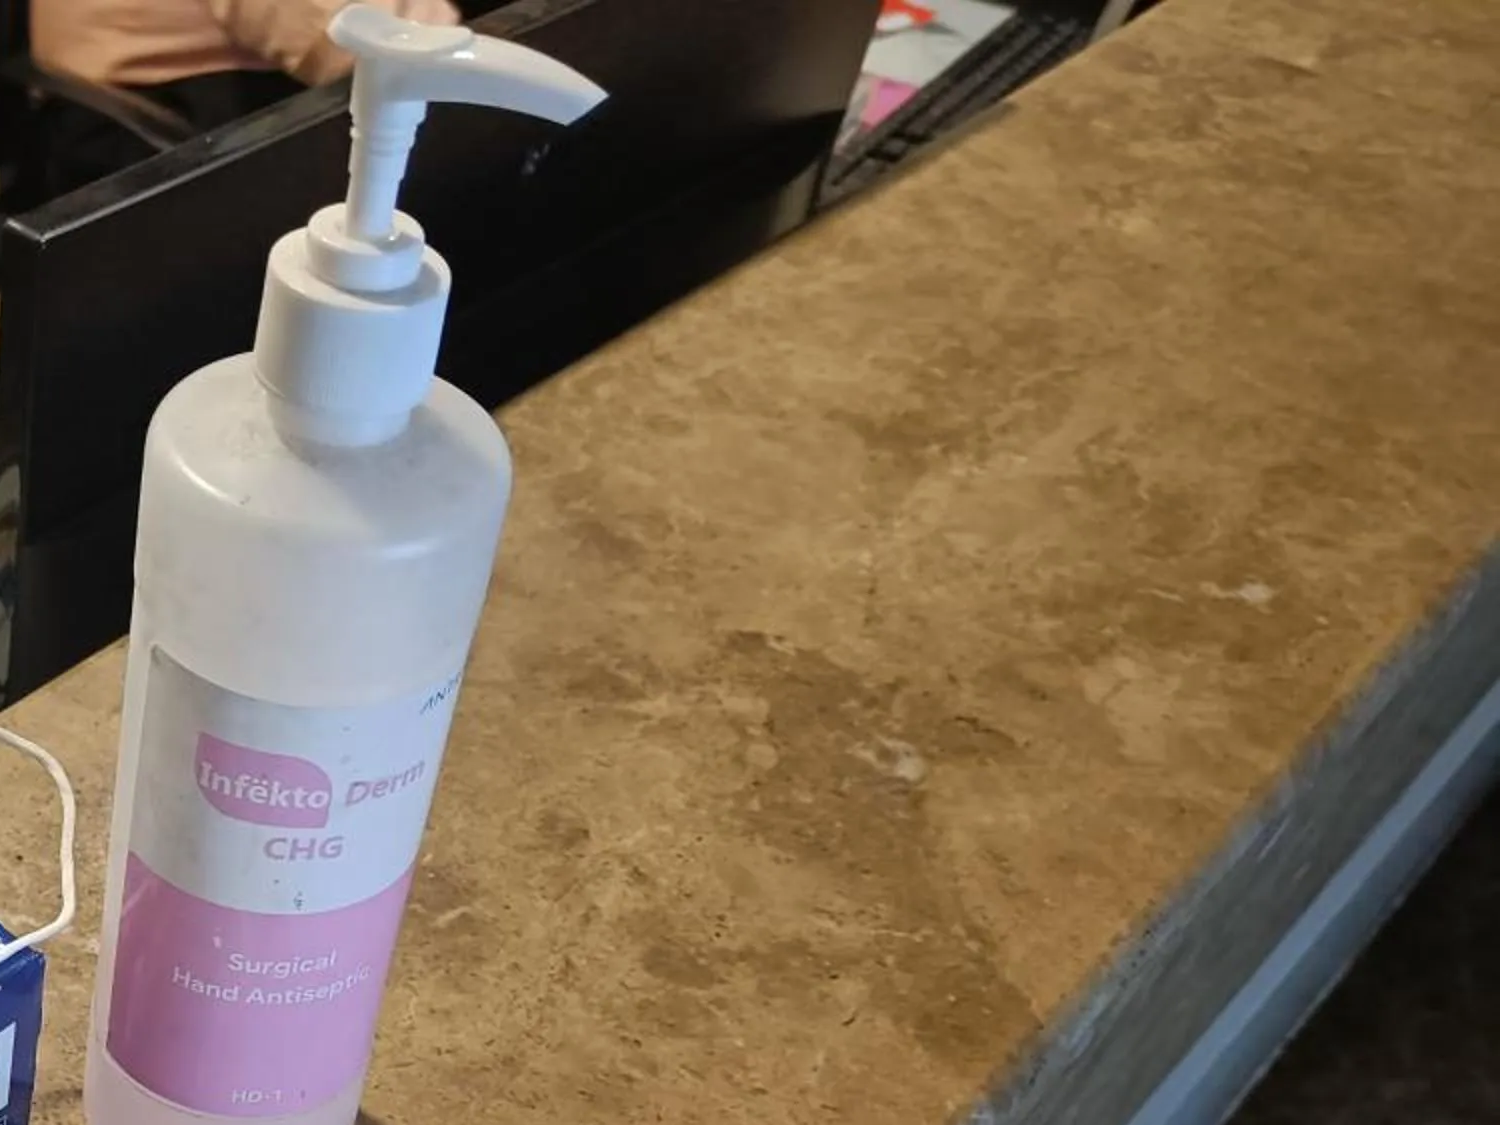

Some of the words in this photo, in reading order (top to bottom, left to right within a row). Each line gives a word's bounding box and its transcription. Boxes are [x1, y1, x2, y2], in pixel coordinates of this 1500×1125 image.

[198, 761, 330, 810] Infëkto
[345, 760, 426, 808] Derm
[262, 835, 345, 862] CHG
[228, 948, 337, 979] Surgical
[172, 966, 240, 1002] Hand
[245, 962, 371, 1005] Antiseptic
